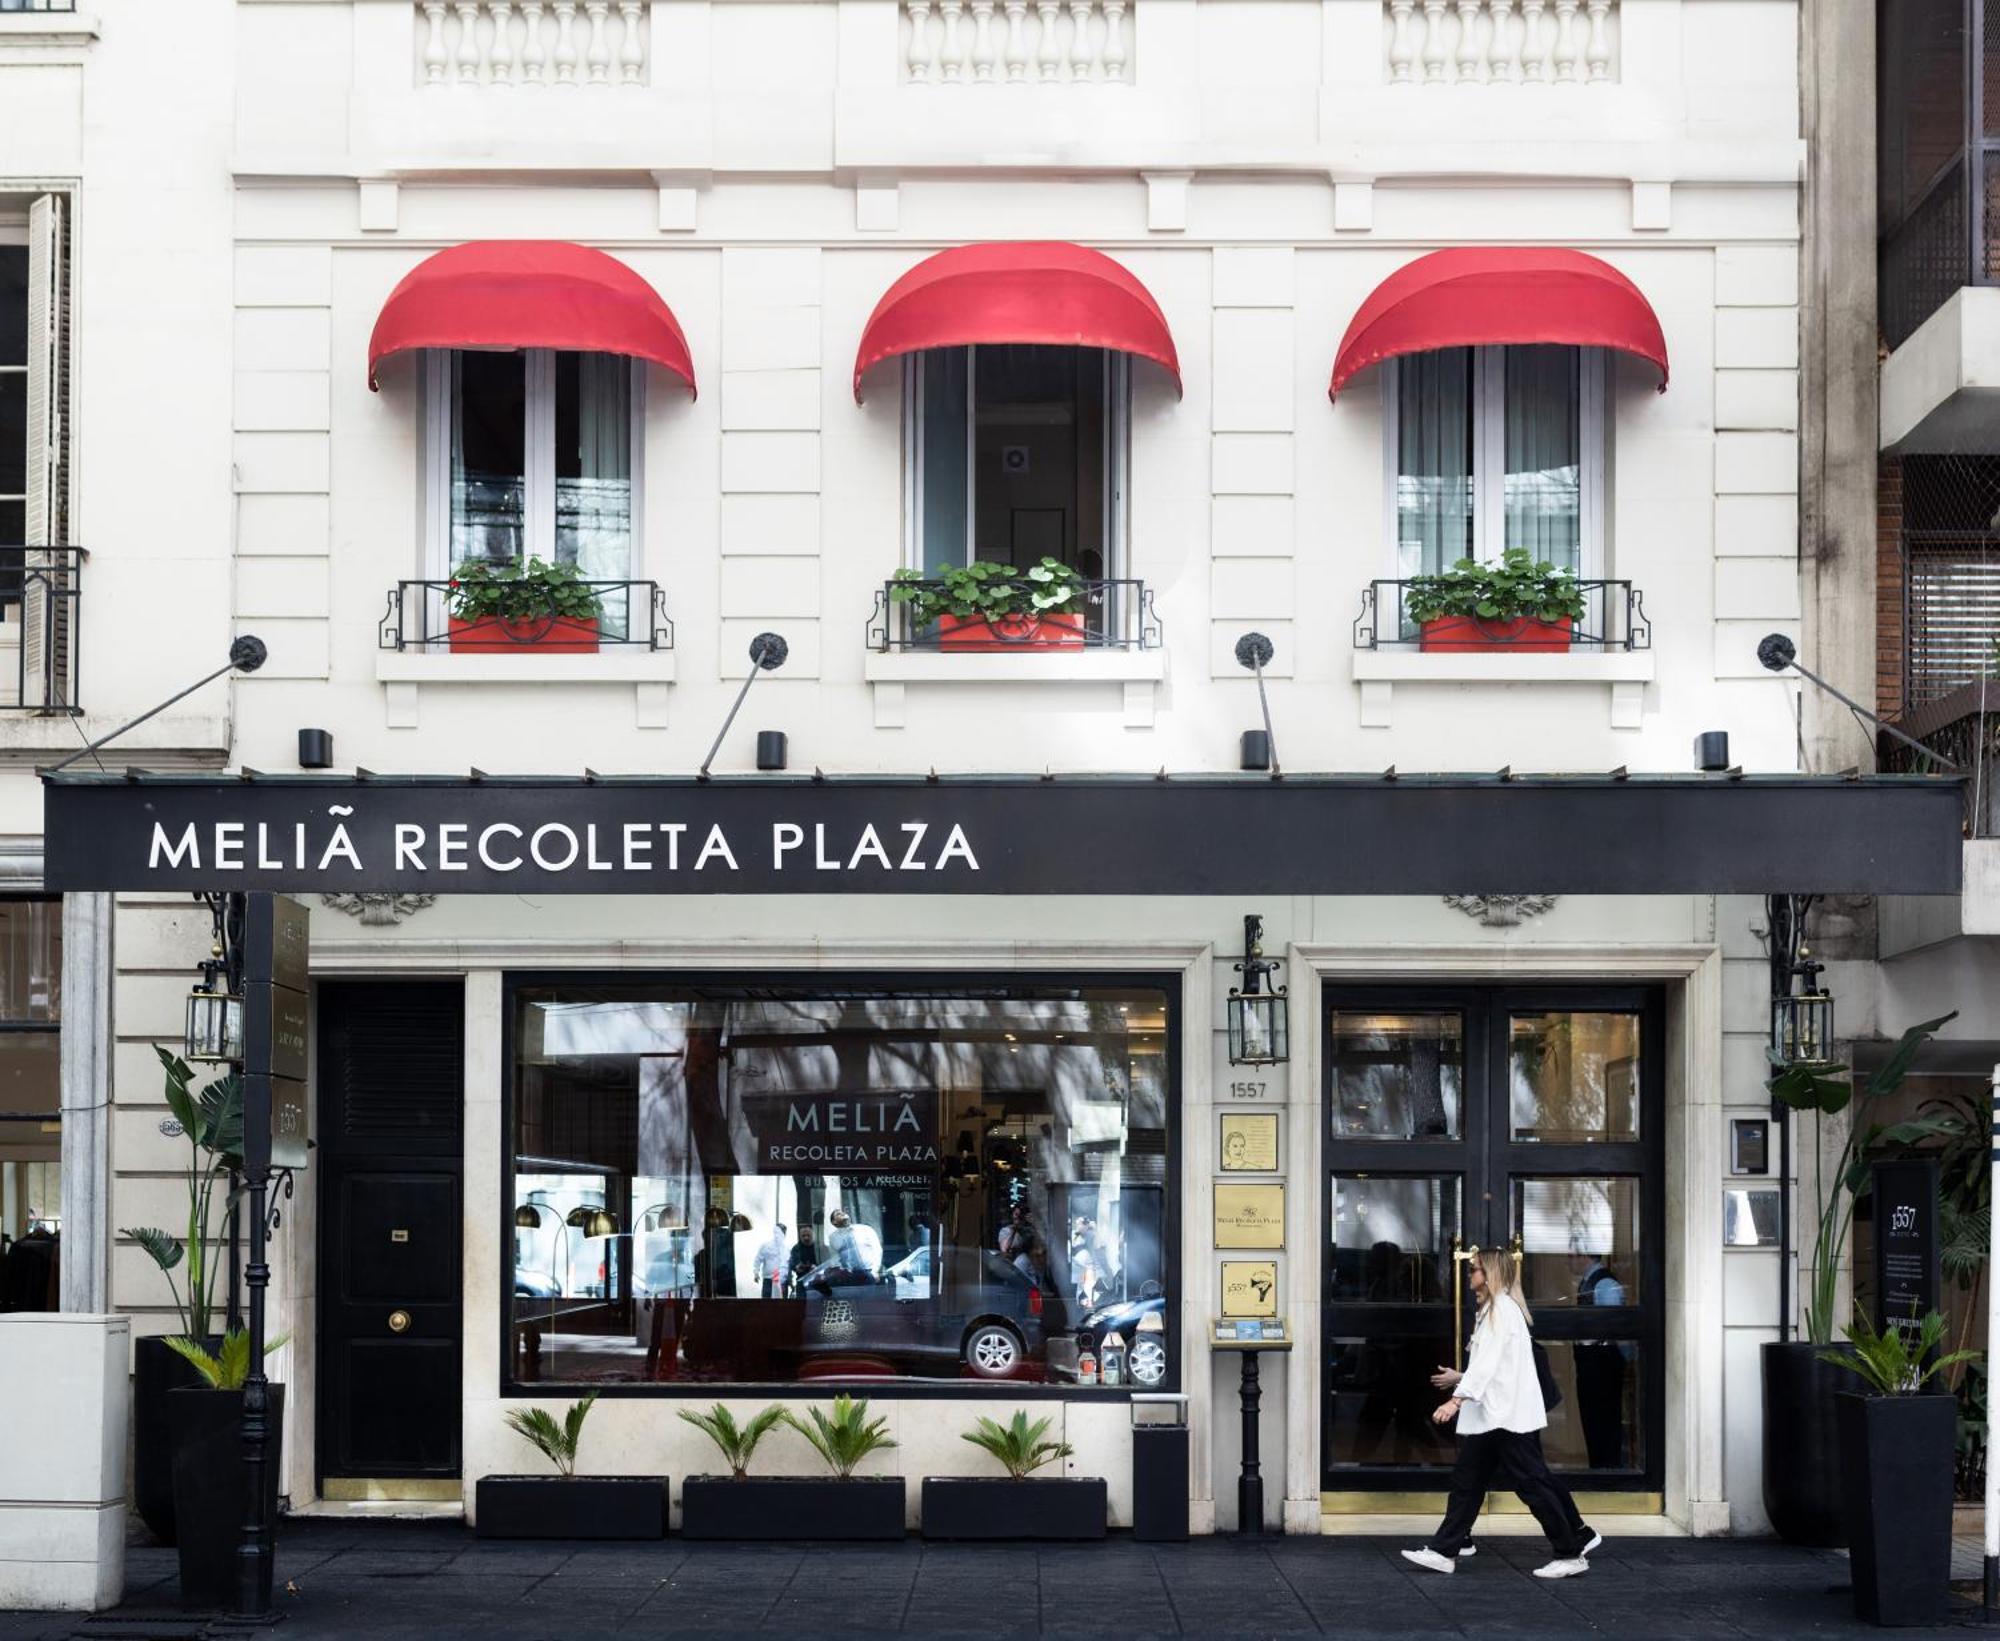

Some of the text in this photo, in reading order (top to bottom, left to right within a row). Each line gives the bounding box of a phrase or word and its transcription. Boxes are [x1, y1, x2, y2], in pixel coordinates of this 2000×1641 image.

[394, 821, 740, 873] RECOLETA
[773, 822, 981, 871] PLAZA
[1230, 1082, 1267, 1099] 1557
[769, 1145, 938, 1162] RECOLETA PLAZA
[804, 1175, 859, 1188] BUOS
[1891, 1205, 1917, 1231] 1557
